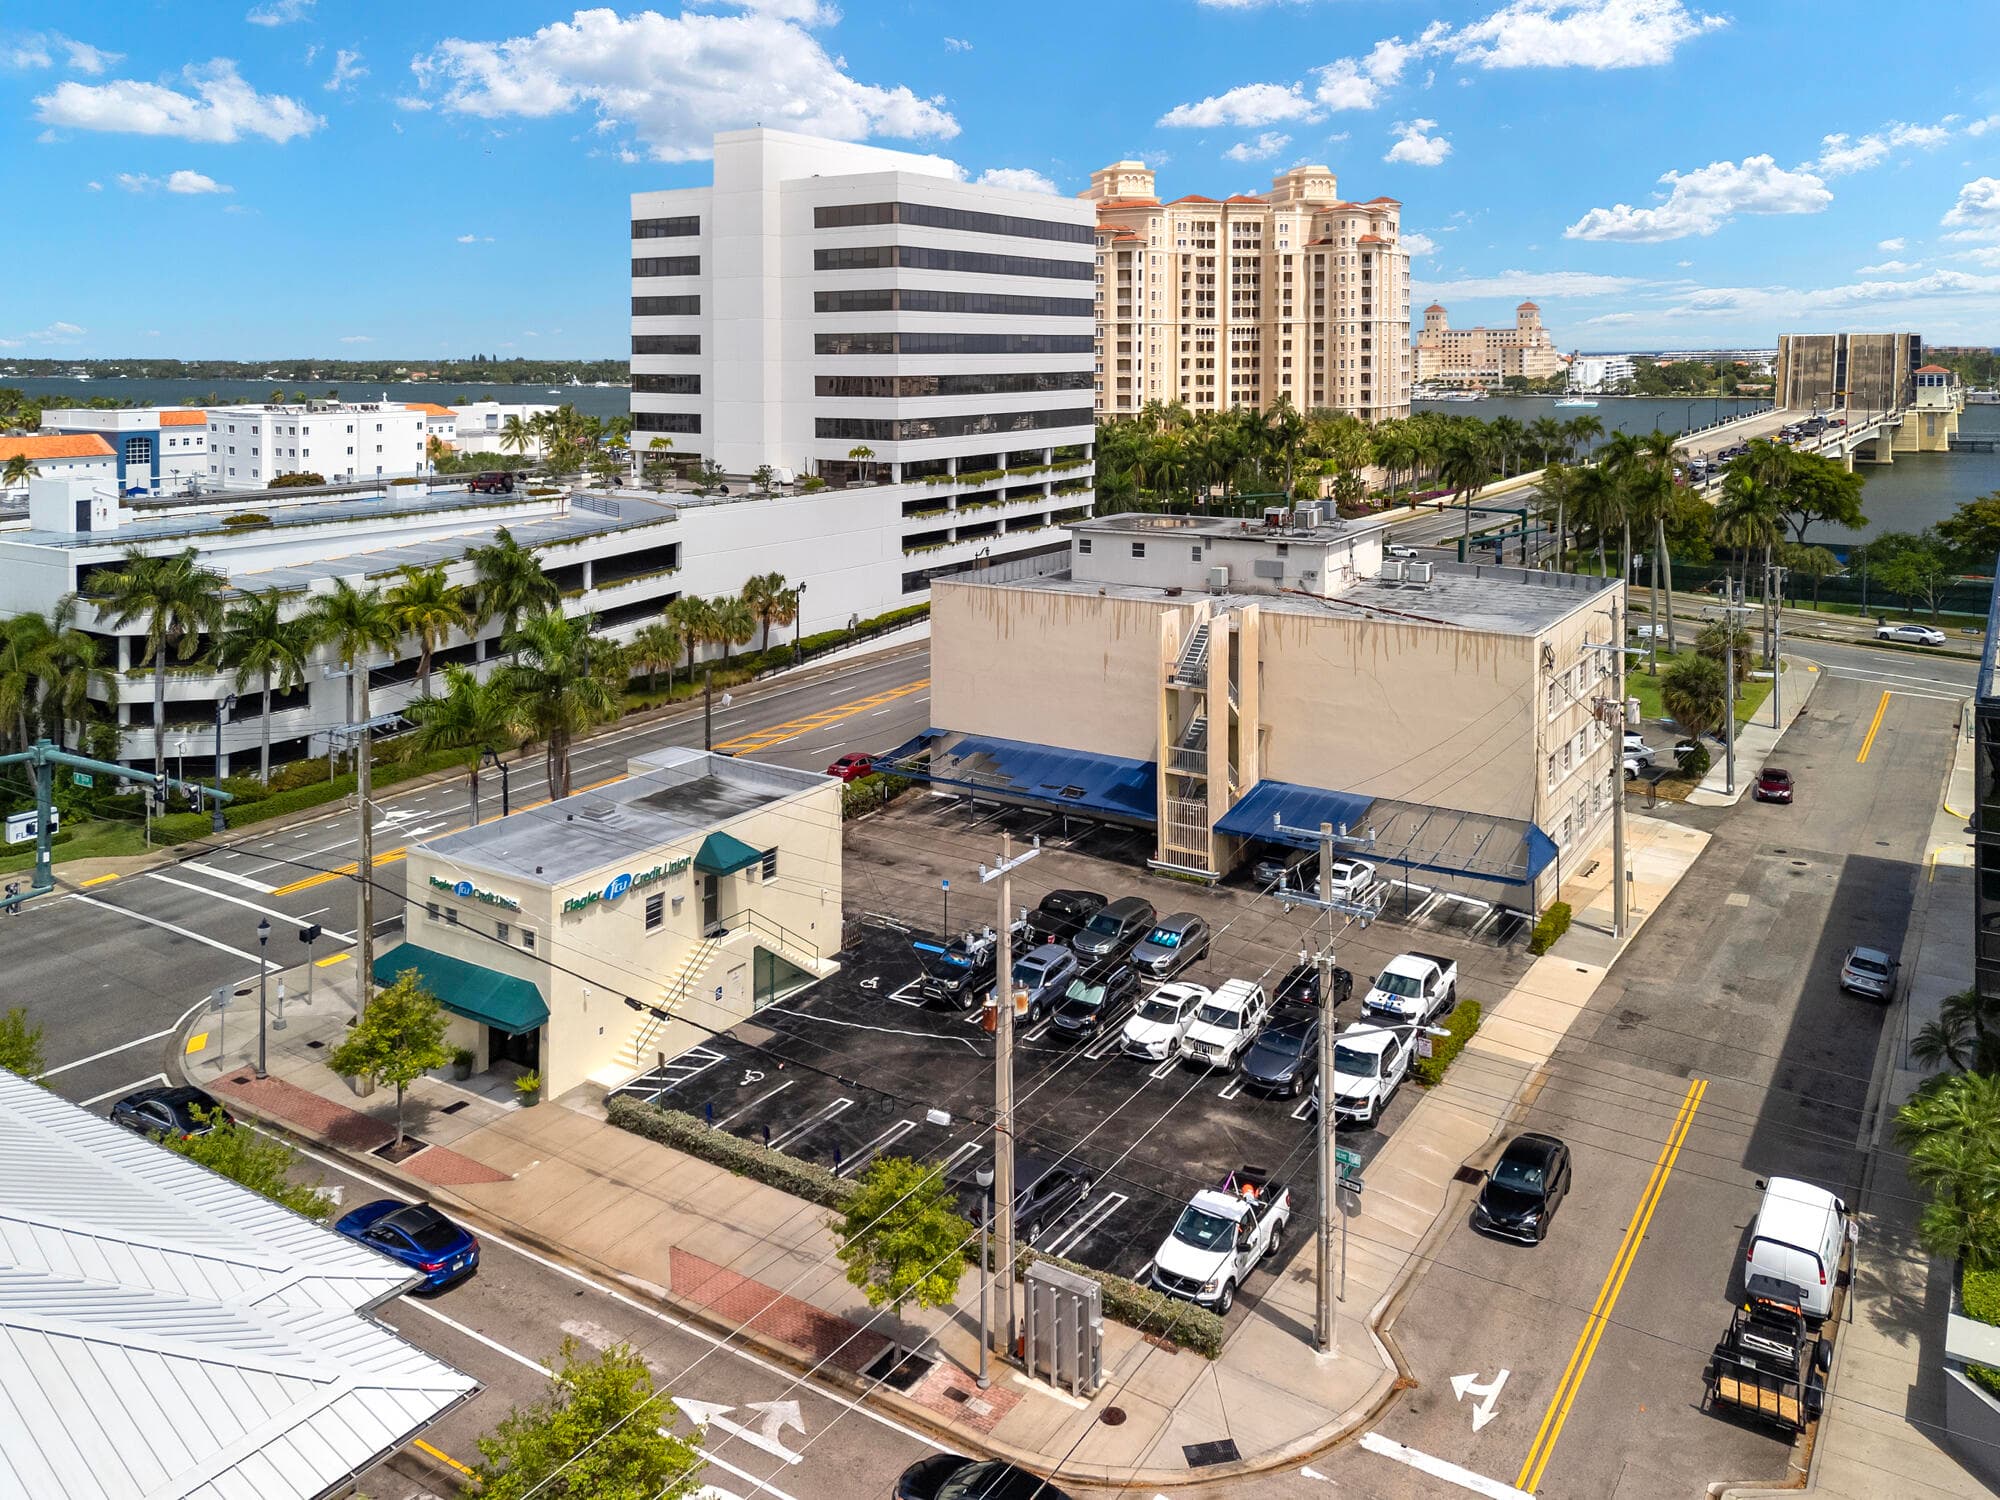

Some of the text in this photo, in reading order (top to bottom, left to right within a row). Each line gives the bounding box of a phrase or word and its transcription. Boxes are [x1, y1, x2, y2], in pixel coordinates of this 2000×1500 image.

[563, 890, 602, 913] Flagler
[632, 866, 661, 887] Credit
[664, 856, 691, 875] Union
